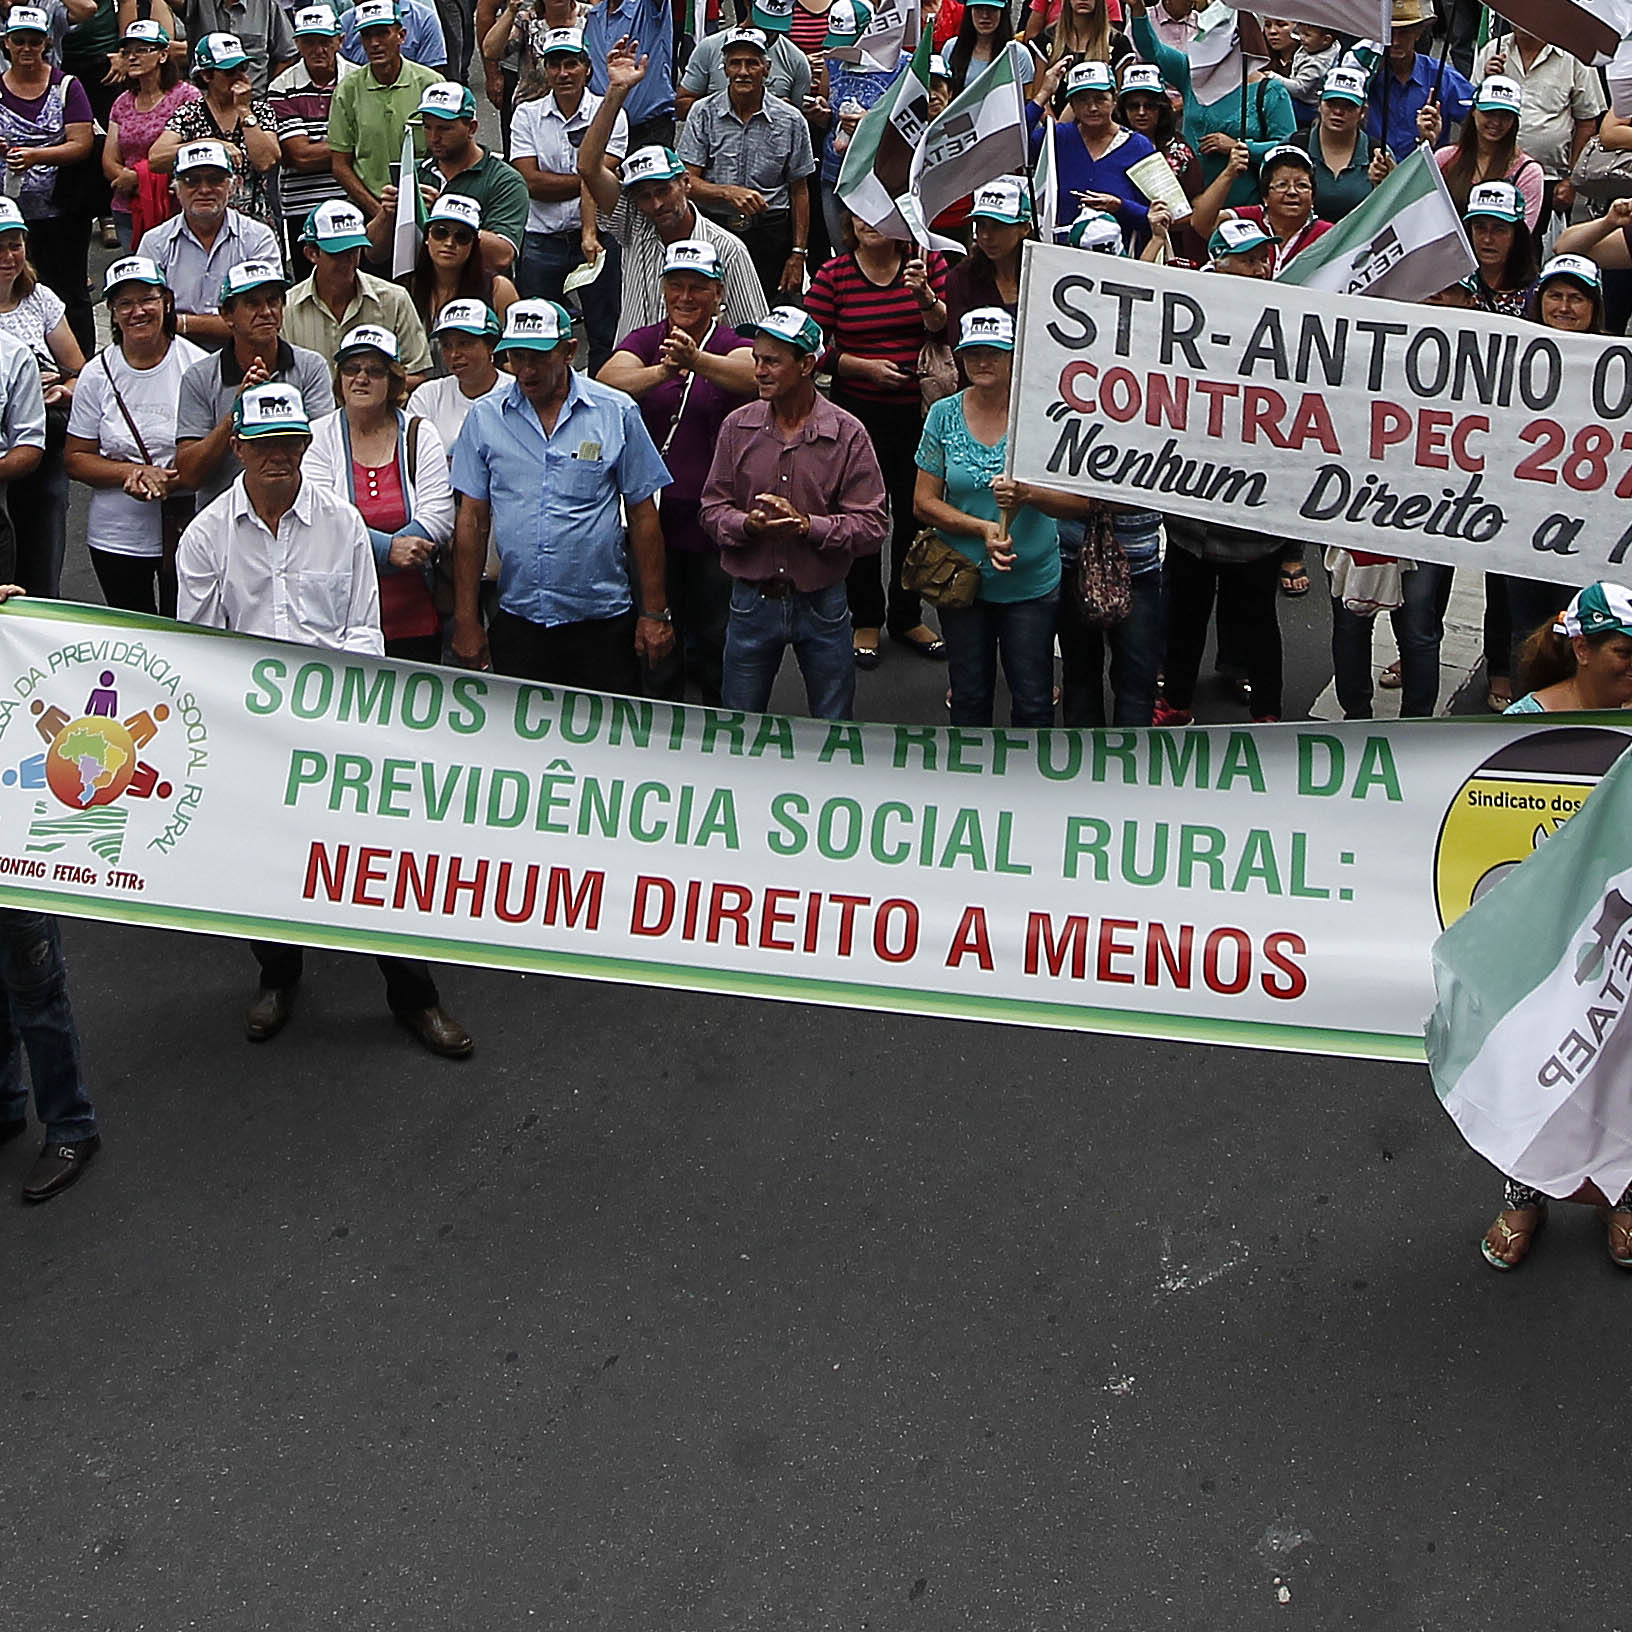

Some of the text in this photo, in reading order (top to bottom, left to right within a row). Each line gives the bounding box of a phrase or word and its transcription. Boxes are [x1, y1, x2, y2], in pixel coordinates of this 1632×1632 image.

[1045, 274, 1563, 412] STR-ANTONIO
[1058, 360, 1342, 455] CONTRA
[1370, 401, 1490, 472] PEC
[1300, 464, 1509, 543] Direito
[1531, 512, 1581, 555] a
[13, 668, 47, 699] DA
[176, 691, 210, 777] SOCIAL
[246, 657, 487, 735] SOMOS
[818, 724, 865, 766] A
[1297, 733, 1404, 803] DA
[146, 782, 206, 856] RURAL
[284, 749, 1355, 901] PREVIDÊNCIA SOCIAL RURAL:
[1467, 789, 1582, 814] Sindicato dos
[52, 861, 98, 887] FETAGs
[105, 870, 146, 893] STTRs
[303, 841, 1308, 1001] NENHUM DIREITO A MENOS
